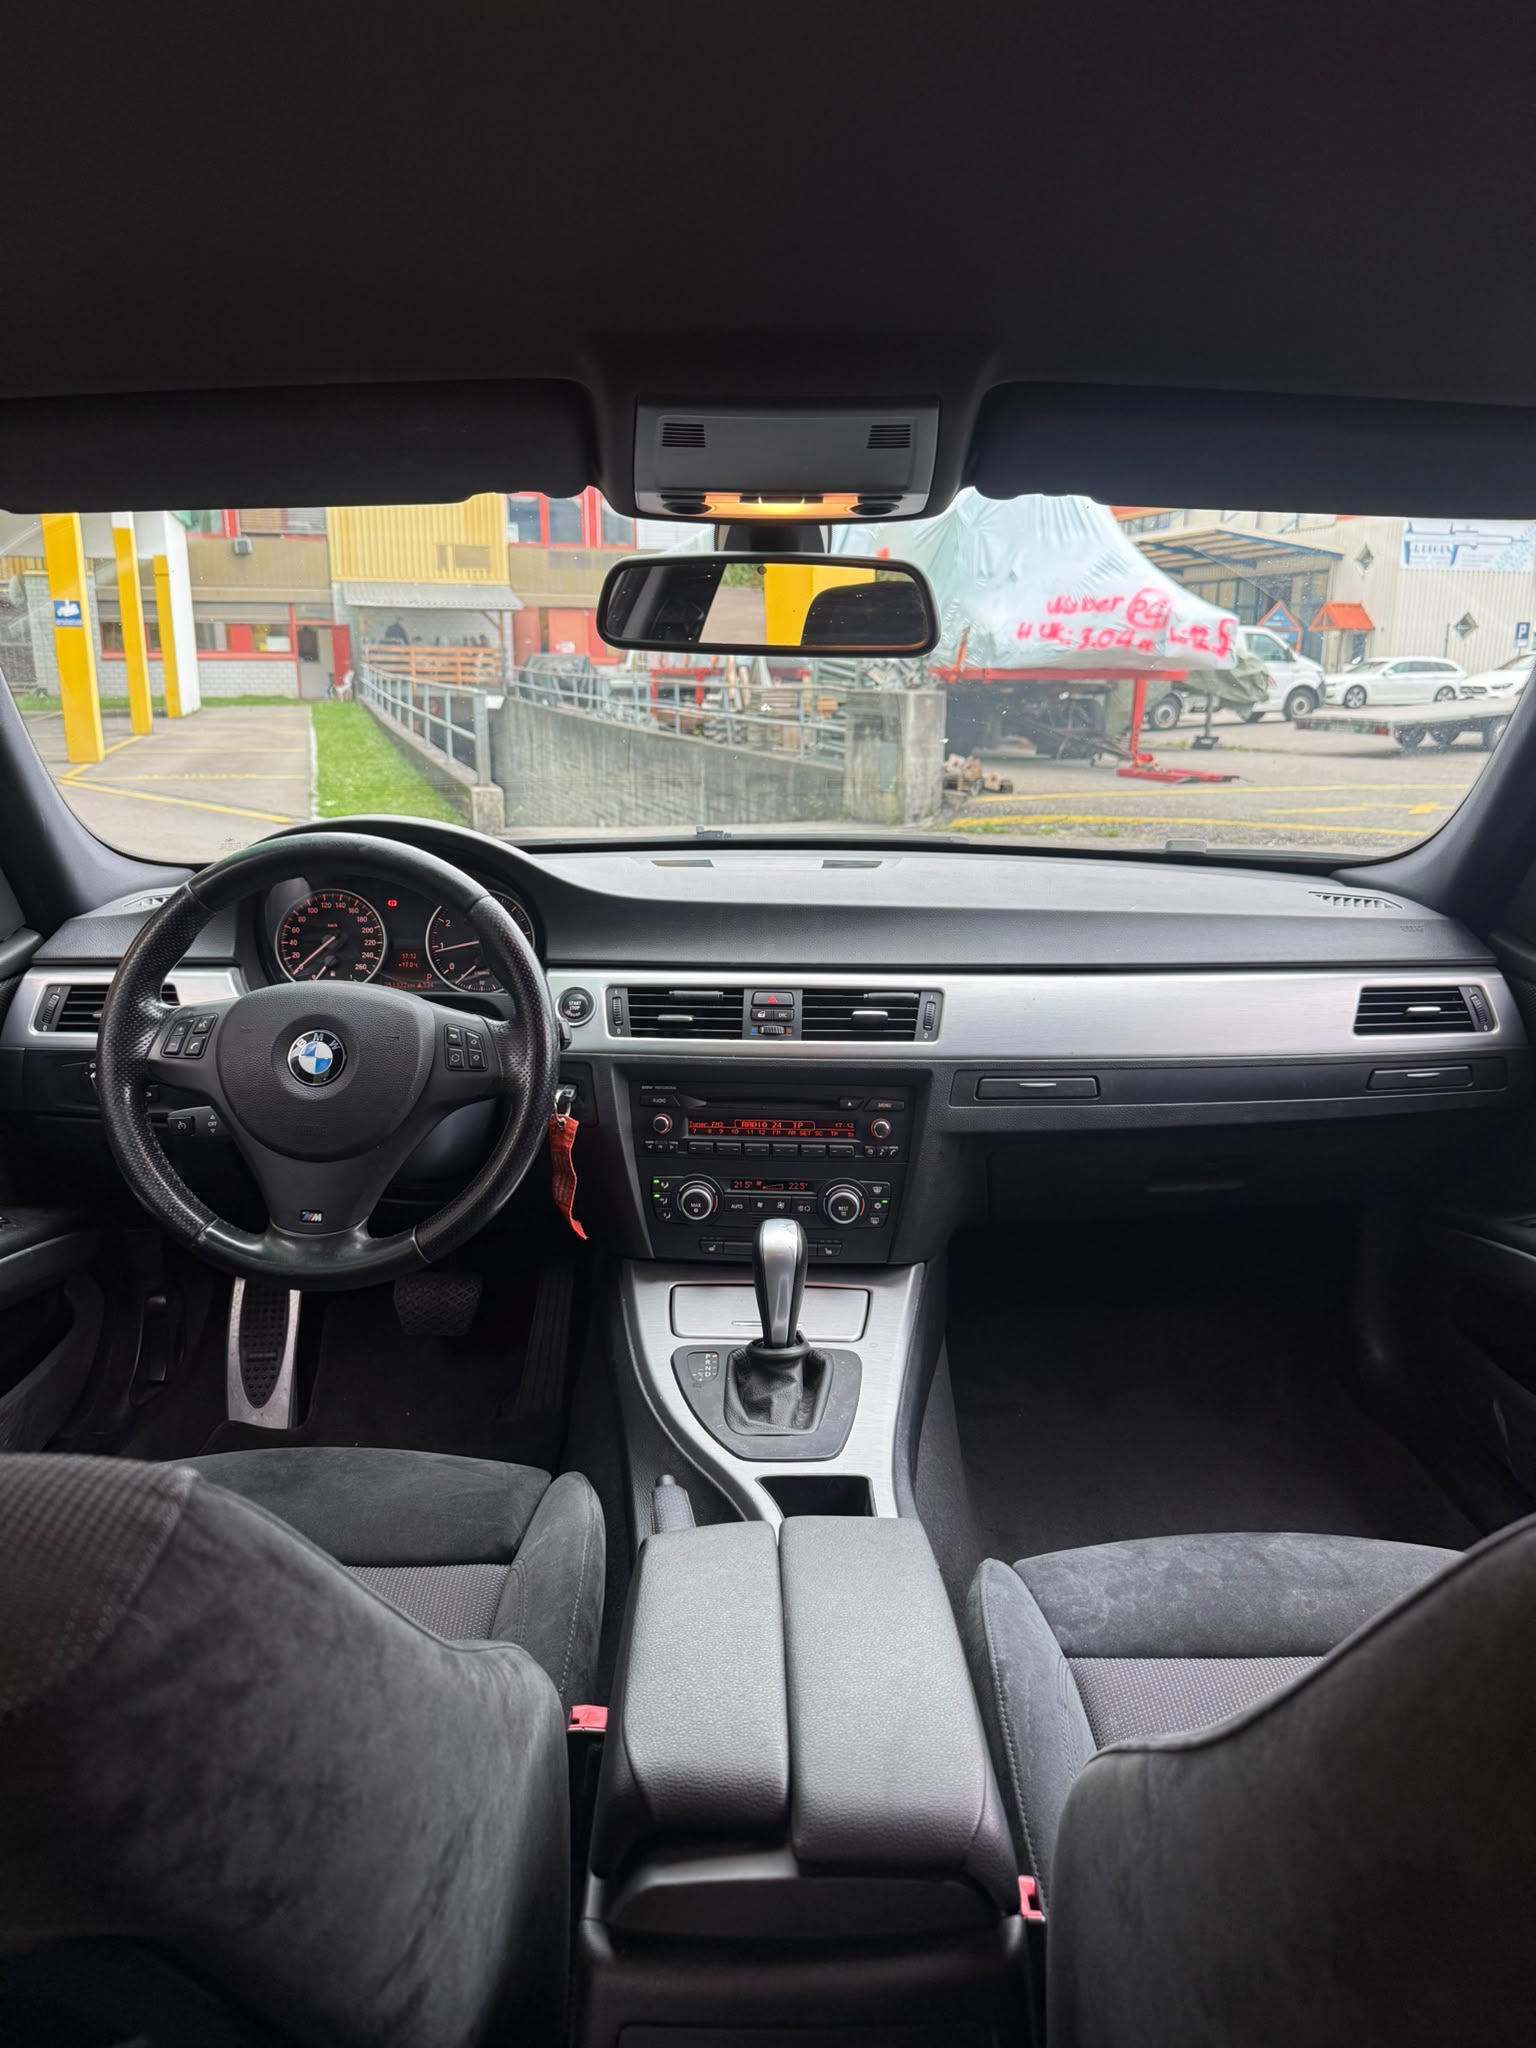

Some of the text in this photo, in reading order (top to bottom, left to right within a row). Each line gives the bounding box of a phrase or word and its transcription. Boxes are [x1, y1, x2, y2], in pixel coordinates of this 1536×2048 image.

[1519, 624, 1528, 638] P
[321, 902, 332, 910] 120
[335, 902, 346, 910] 140
[307, 907, 318, 915] 100
[348, 907, 359, 915] 160
[298, 915, 306, 924] 80
[357, 916, 368, 924] 180
[445, 919, 451, 927] 2
[291, 926, 300, 935] 60
[361, 927, 374, 935] 200
[289, 939, 298, 947] 40
[364, 939, 376, 947] 220
[292, 951, 300, 959] 20
[361, 951, 374, 959] 240
[355, 963, 367, 971] 260
[449, 962, 455, 970] 0
[426, 973, 433, 981] P
[296, 1032, 341, 1051] BMW
[741, 1121, 782, 1129] RADIO 24
